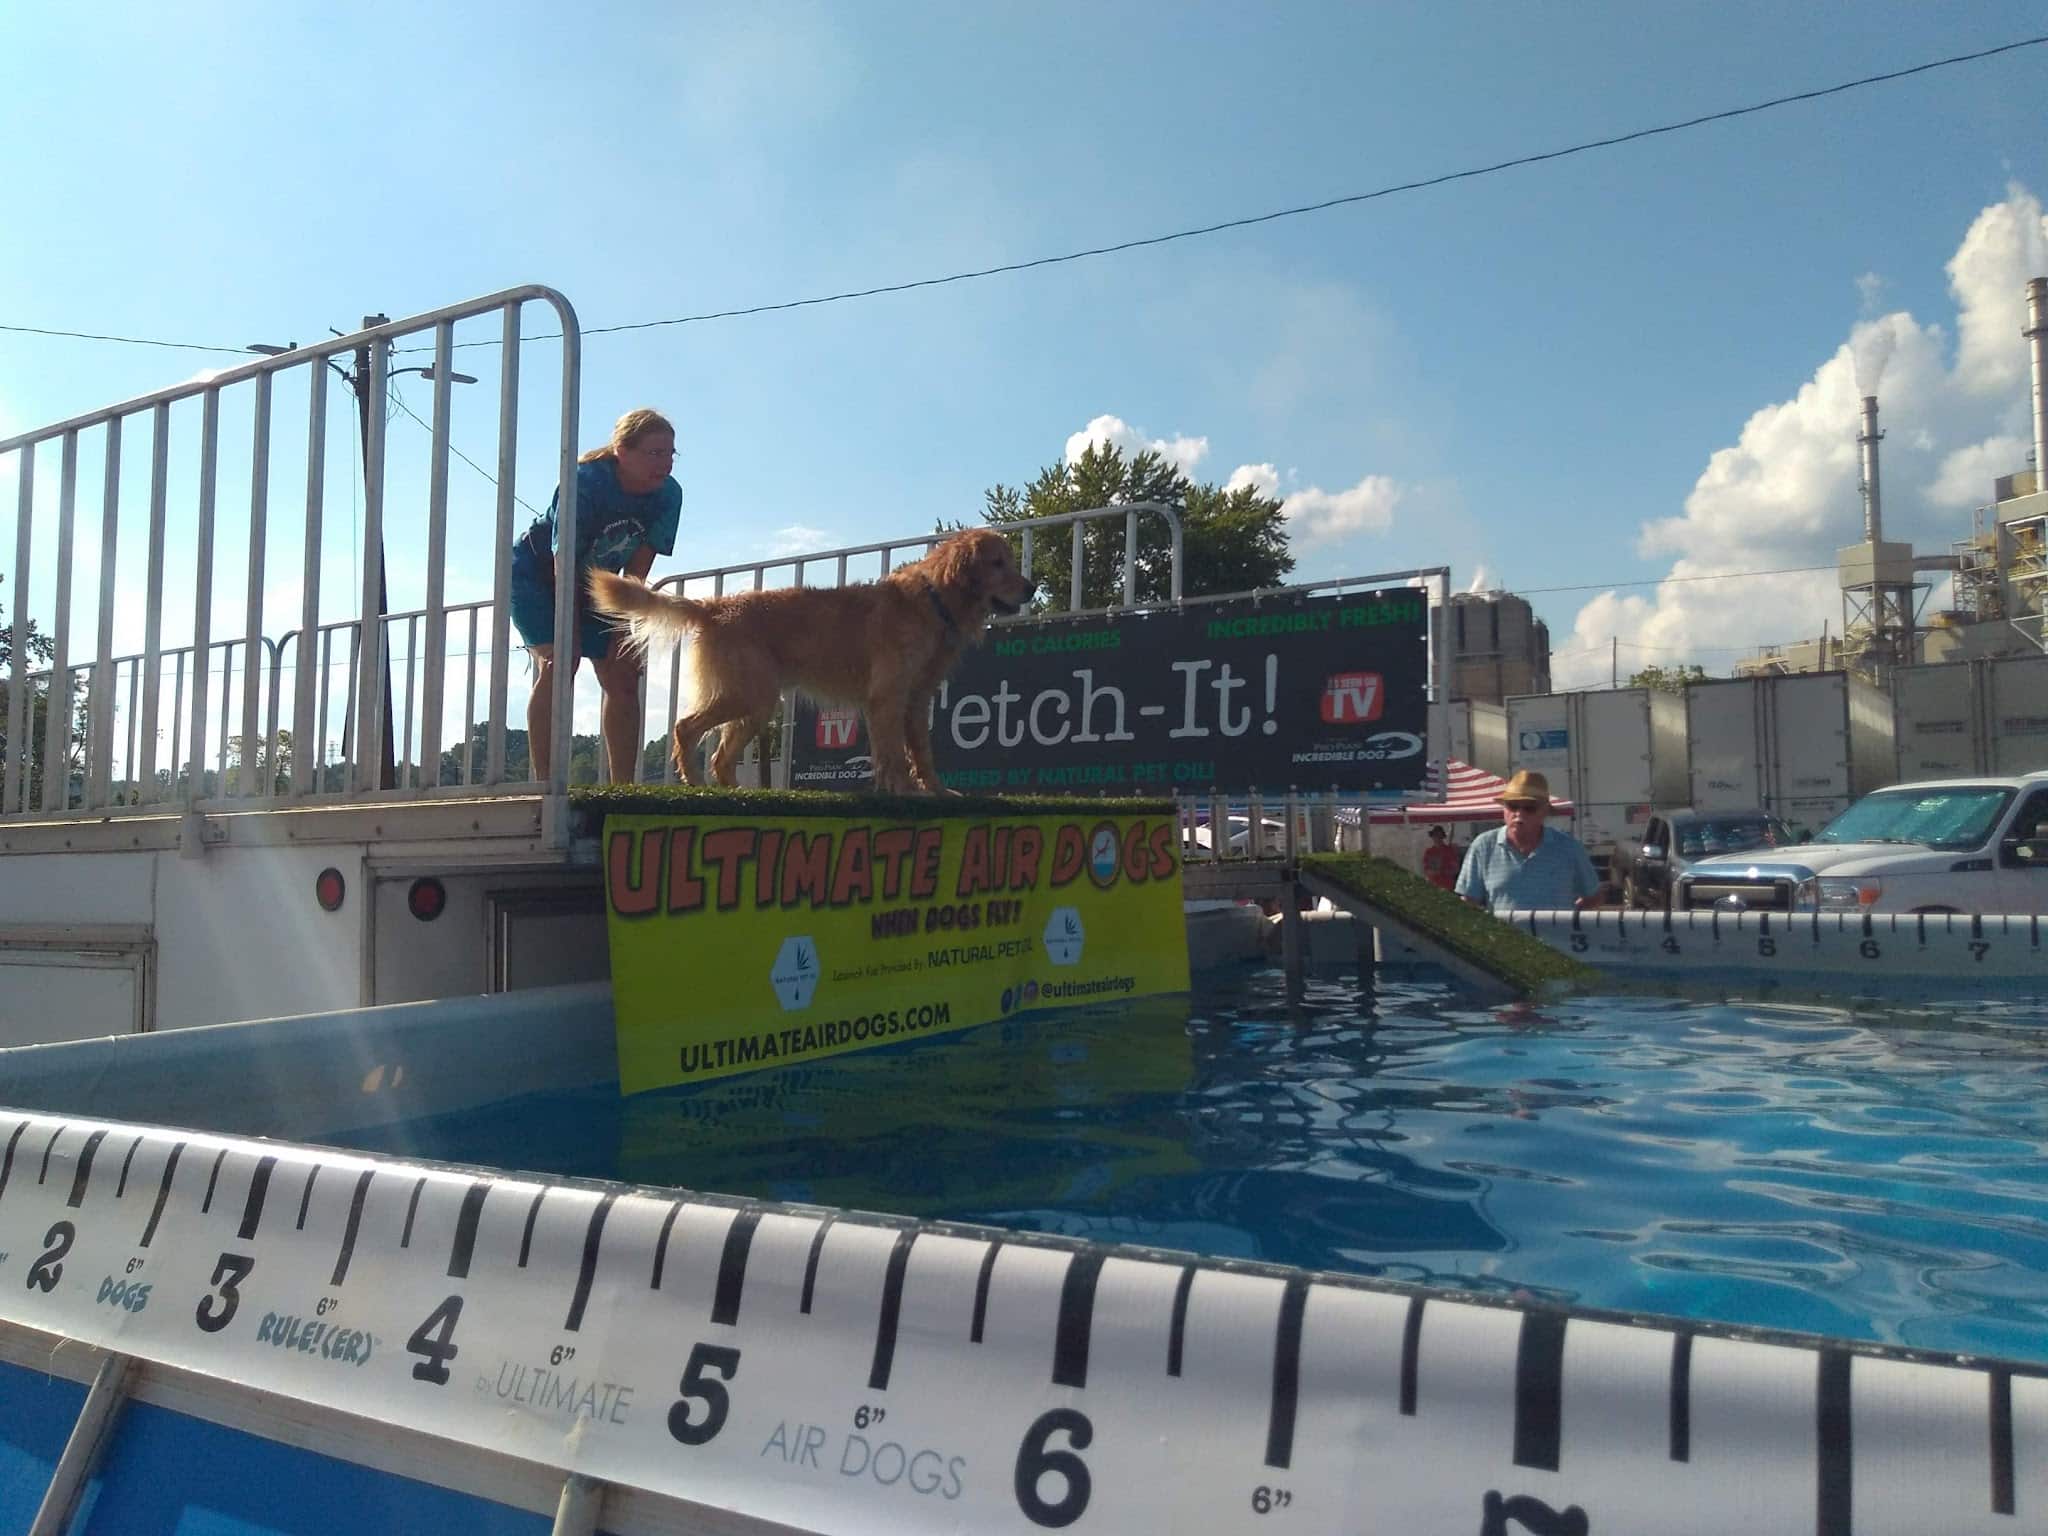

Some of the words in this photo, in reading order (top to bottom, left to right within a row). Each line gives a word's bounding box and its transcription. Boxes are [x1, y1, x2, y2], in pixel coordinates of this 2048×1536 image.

[1207, 612, 1330, 639] INCREDIBLY
[1340, 602, 1420, 626] FRESH!
[995, 638, 1025, 656] NO
[1031, 629, 1121, 655] CALORIES
[926, 653, 1279, 750] etch-It!
[1328, 686, 1377, 719] TV
[820, 719, 854, 745] TV
[838, 769, 857, 779] DOG
[1292, 751, 1354, 763] INCREDIBLE
[1357, 750, 1386, 761] DOG
[936, 767, 1001, 788] WERED
[1007, 766, 1031, 785] BY
[1037, 763, 1128, 785] NATURAL
[1133, 761, 1167, 781] PET
[608, 825, 943, 918] ULTIMATE
[955, 824, 1044, 897] AIR
[1049, 820, 1178, 889] DOGS
[925, 903, 981, 936] DOGS
[927, 945, 994, 969] NATURAL
[998, 940, 1023, 958] PET
[1570, 933, 1590, 953] 3
[1661, 936, 1681, 954] 4
[1759, 937, 1777, 957] 5
[1859, 940, 1881, 959] 6
[1967, 942, 1990, 961] 7
[680, 1003, 950, 1073] ULTIMATEAIRDOGS.COM
[26, 1221, 76, 1293] 2
[96, 1275, 153, 1312] DOGS
[195, 1252, 255, 1332] 3
[256, 1312, 373, 1367] RULE!(ER)
[406, 1295, 464, 1385] 4
[496, 1360, 635, 1424] ULTIMATE
[667, 1342, 741, 1445] 5
[760, 1420, 826, 1469] AIR
[839, 1434, 967, 1500] DOGS
[1014, 1407, 1093, 1528] 6
